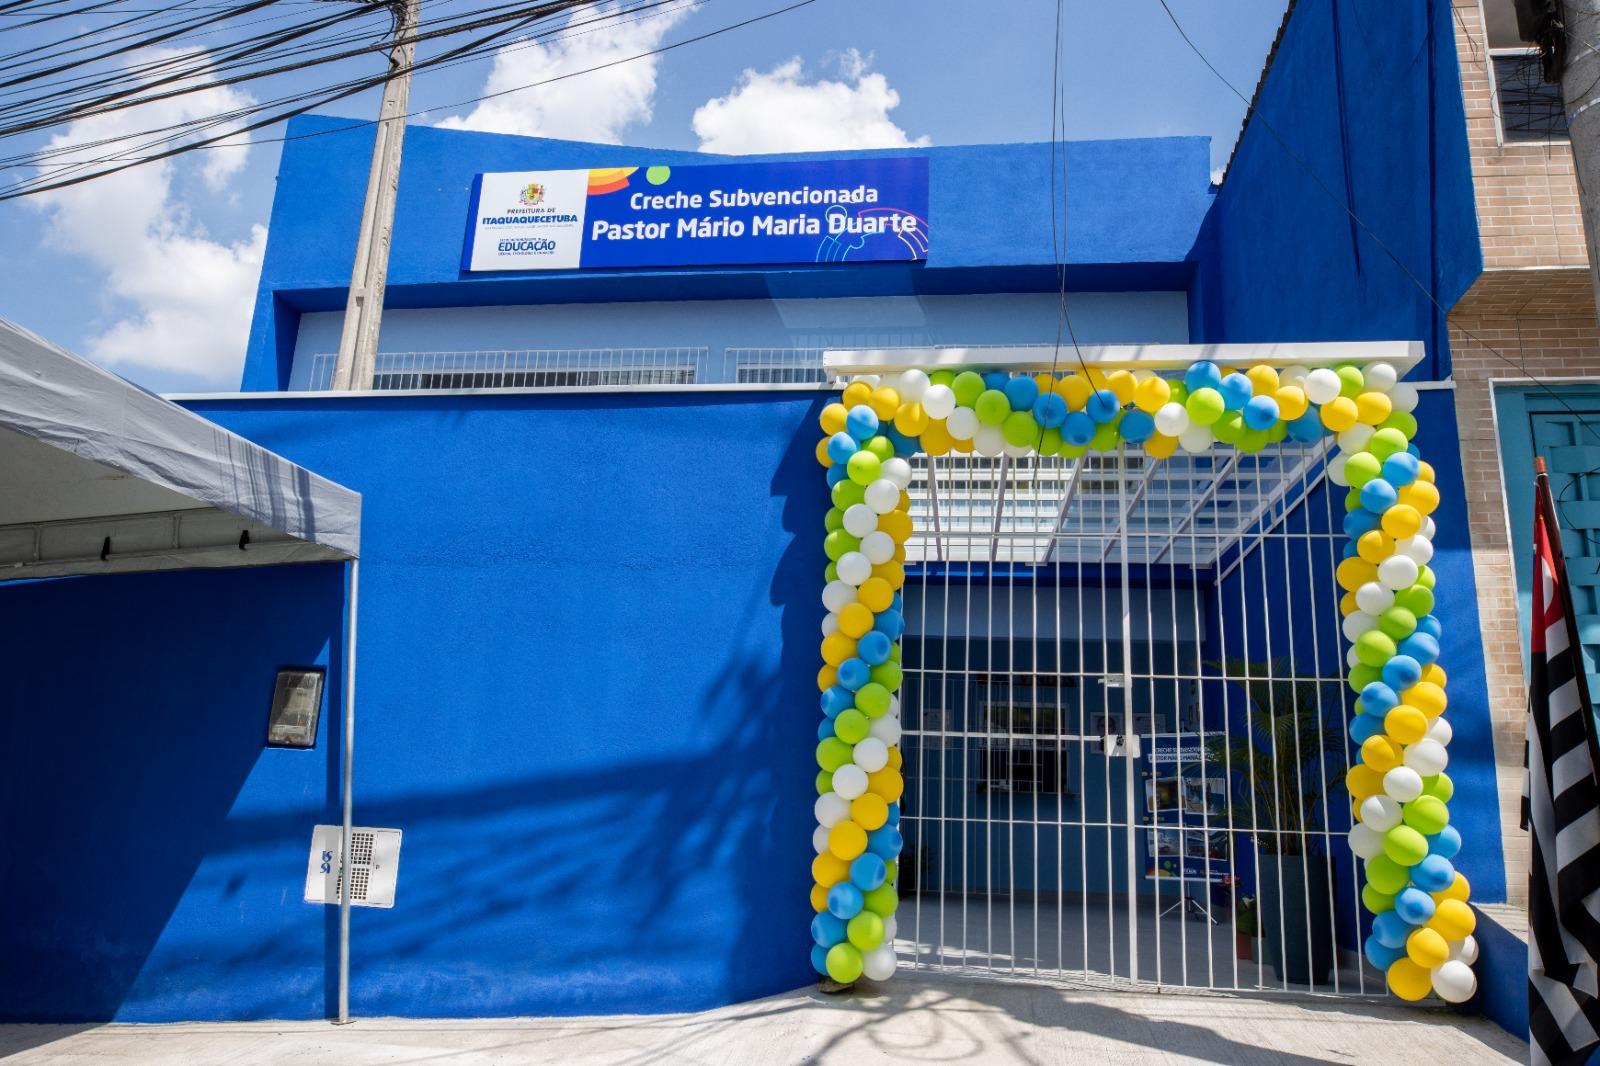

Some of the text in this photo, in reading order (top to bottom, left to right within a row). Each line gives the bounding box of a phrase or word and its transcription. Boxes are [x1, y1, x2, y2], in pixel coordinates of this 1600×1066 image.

[630, 185, 878, 210] Creche Subvencionada
[482, 214, 578, 224] ITAQUAQUECETUBA
[592, 212, 917, 240] Pastor Mário Maria Duarte
[498, 238, 556, 251] EDUCAÇÃO
